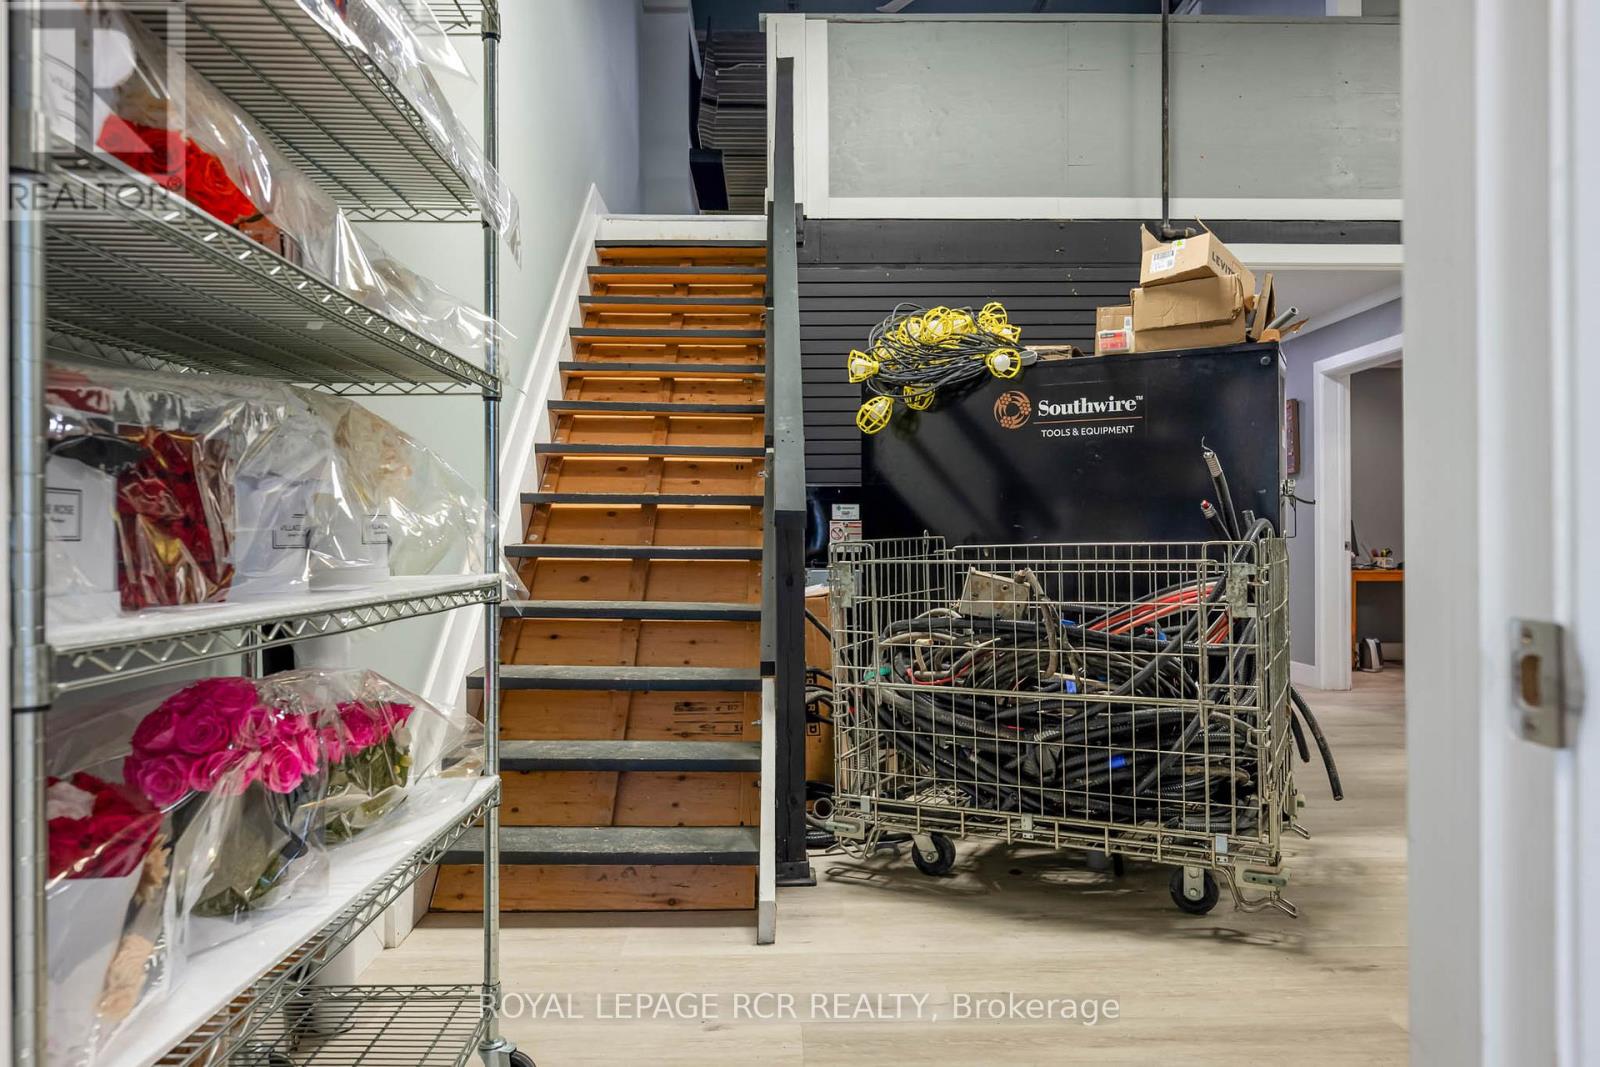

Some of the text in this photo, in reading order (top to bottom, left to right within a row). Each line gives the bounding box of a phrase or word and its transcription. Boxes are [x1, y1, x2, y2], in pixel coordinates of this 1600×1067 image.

[1211, 250, 1236, 275] LEVIT
[1041, 425, 1135, 438] TOOLS & EQUIPMENT
